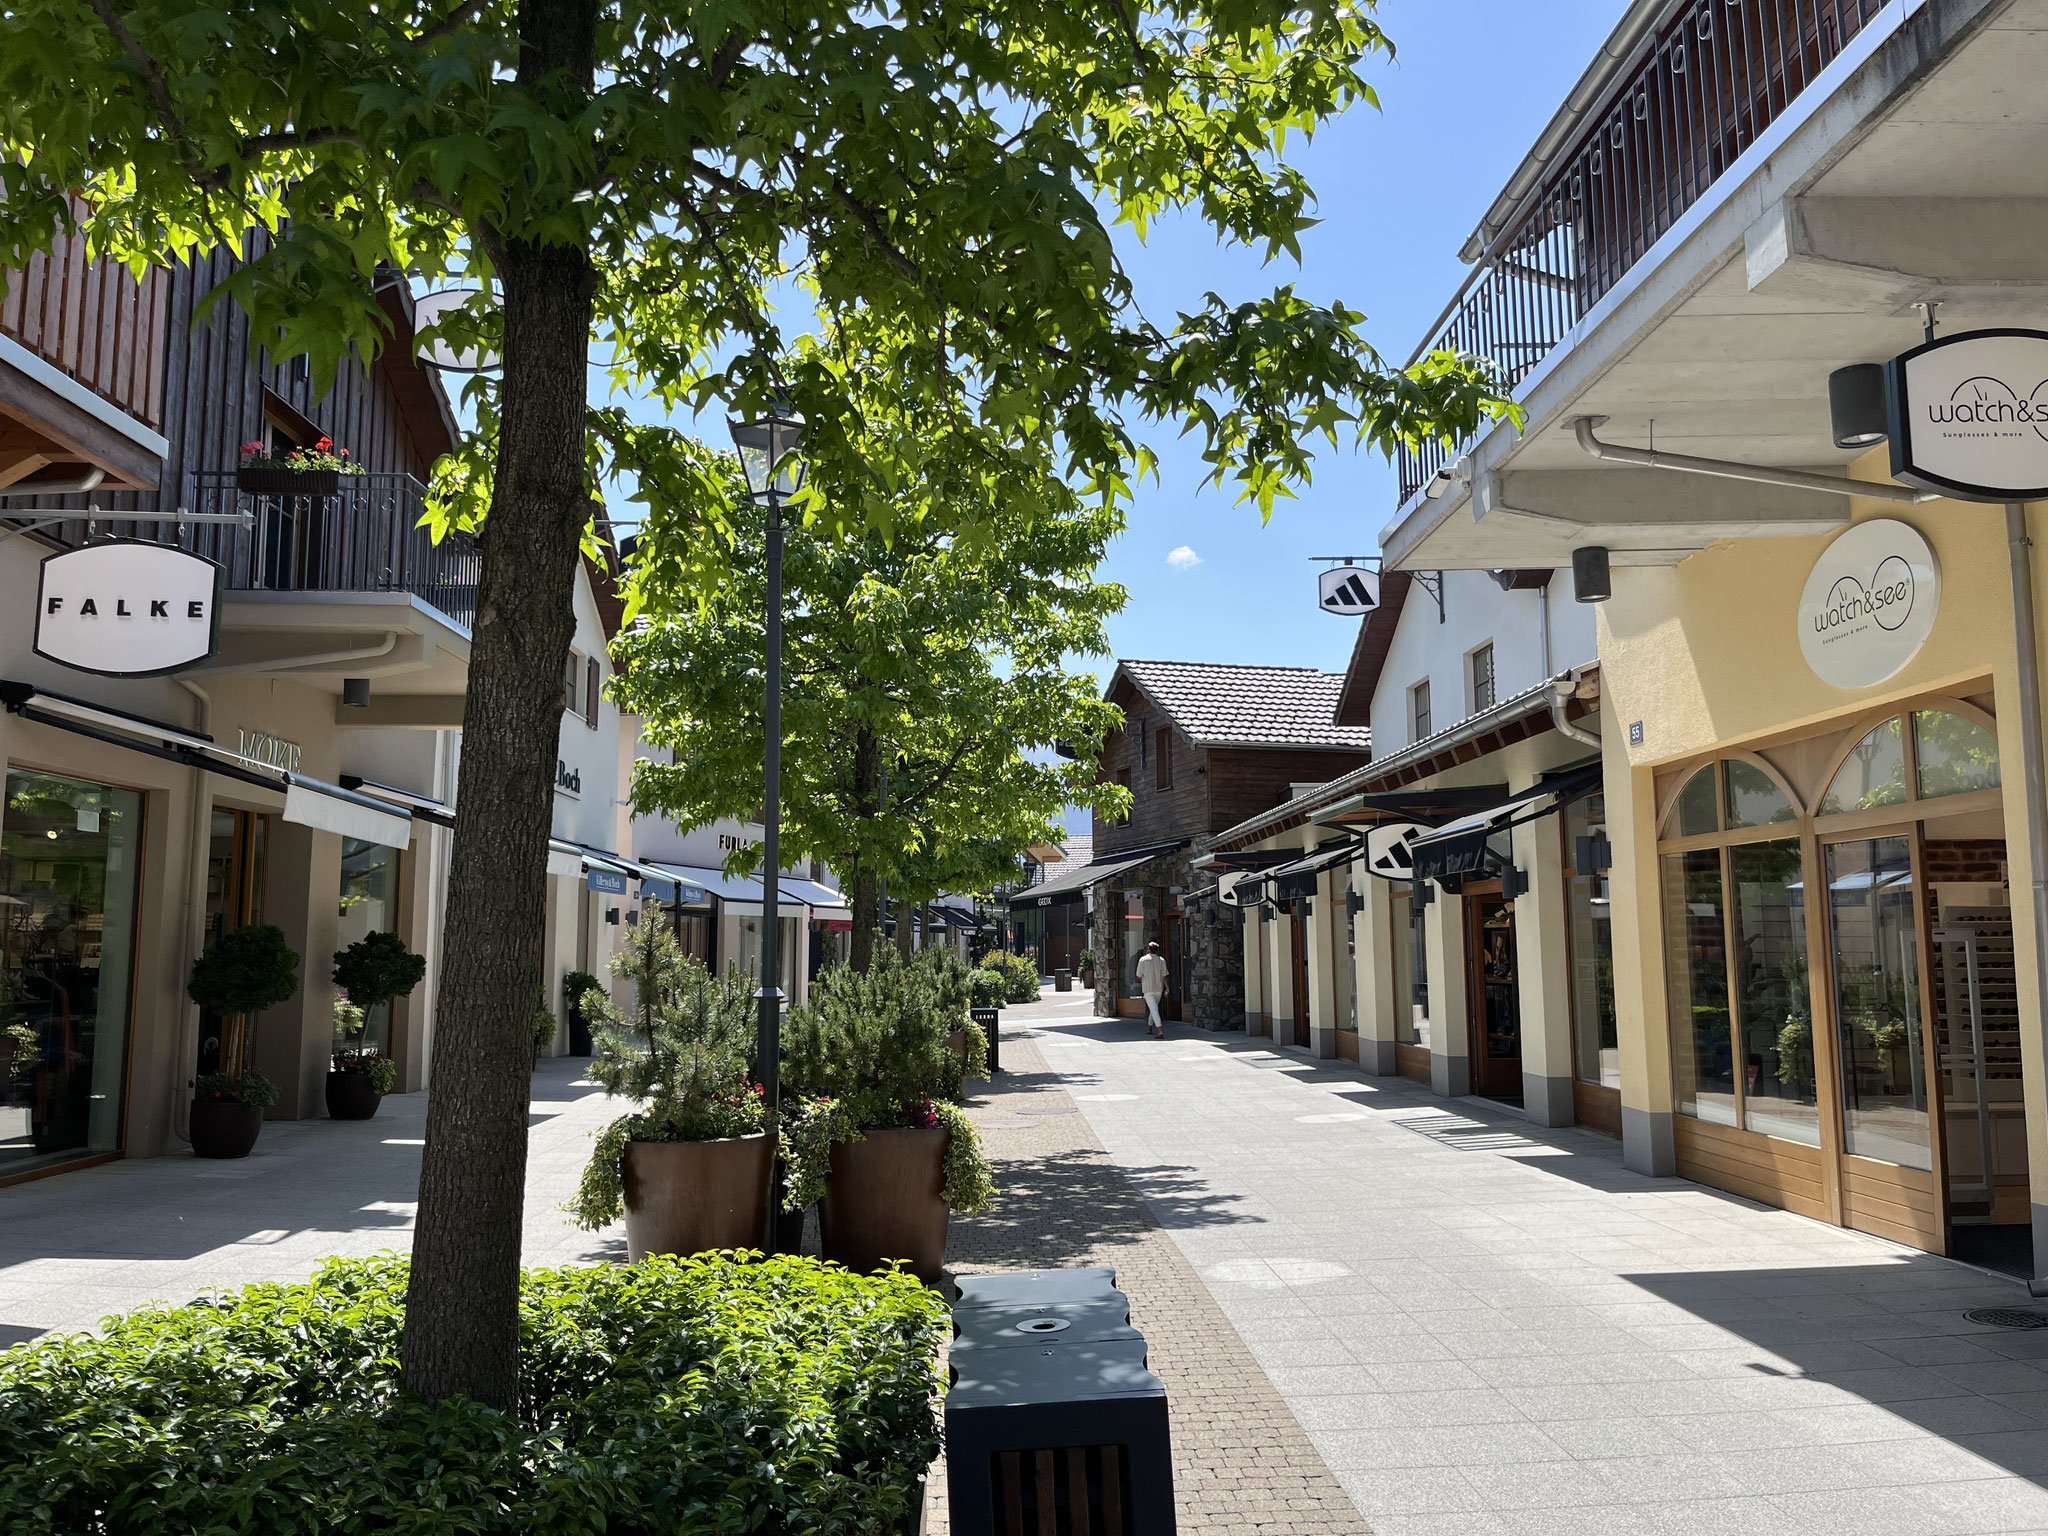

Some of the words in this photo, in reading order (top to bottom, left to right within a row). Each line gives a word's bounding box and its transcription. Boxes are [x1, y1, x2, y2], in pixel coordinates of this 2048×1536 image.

[1942, 431, 1990, 439] Sunglasses
[47, 597, 204, 618] FALKE
[1822, 632, 1849, 645] Sunglasses
[1855, 624, 1868, 633] more
[1631, 725, 1640, 740] 55
[558, 759, 581, 794] Boch
[717, 834, 748, 852] FURLA
[1037, 896, 1052, 907] GEOX
